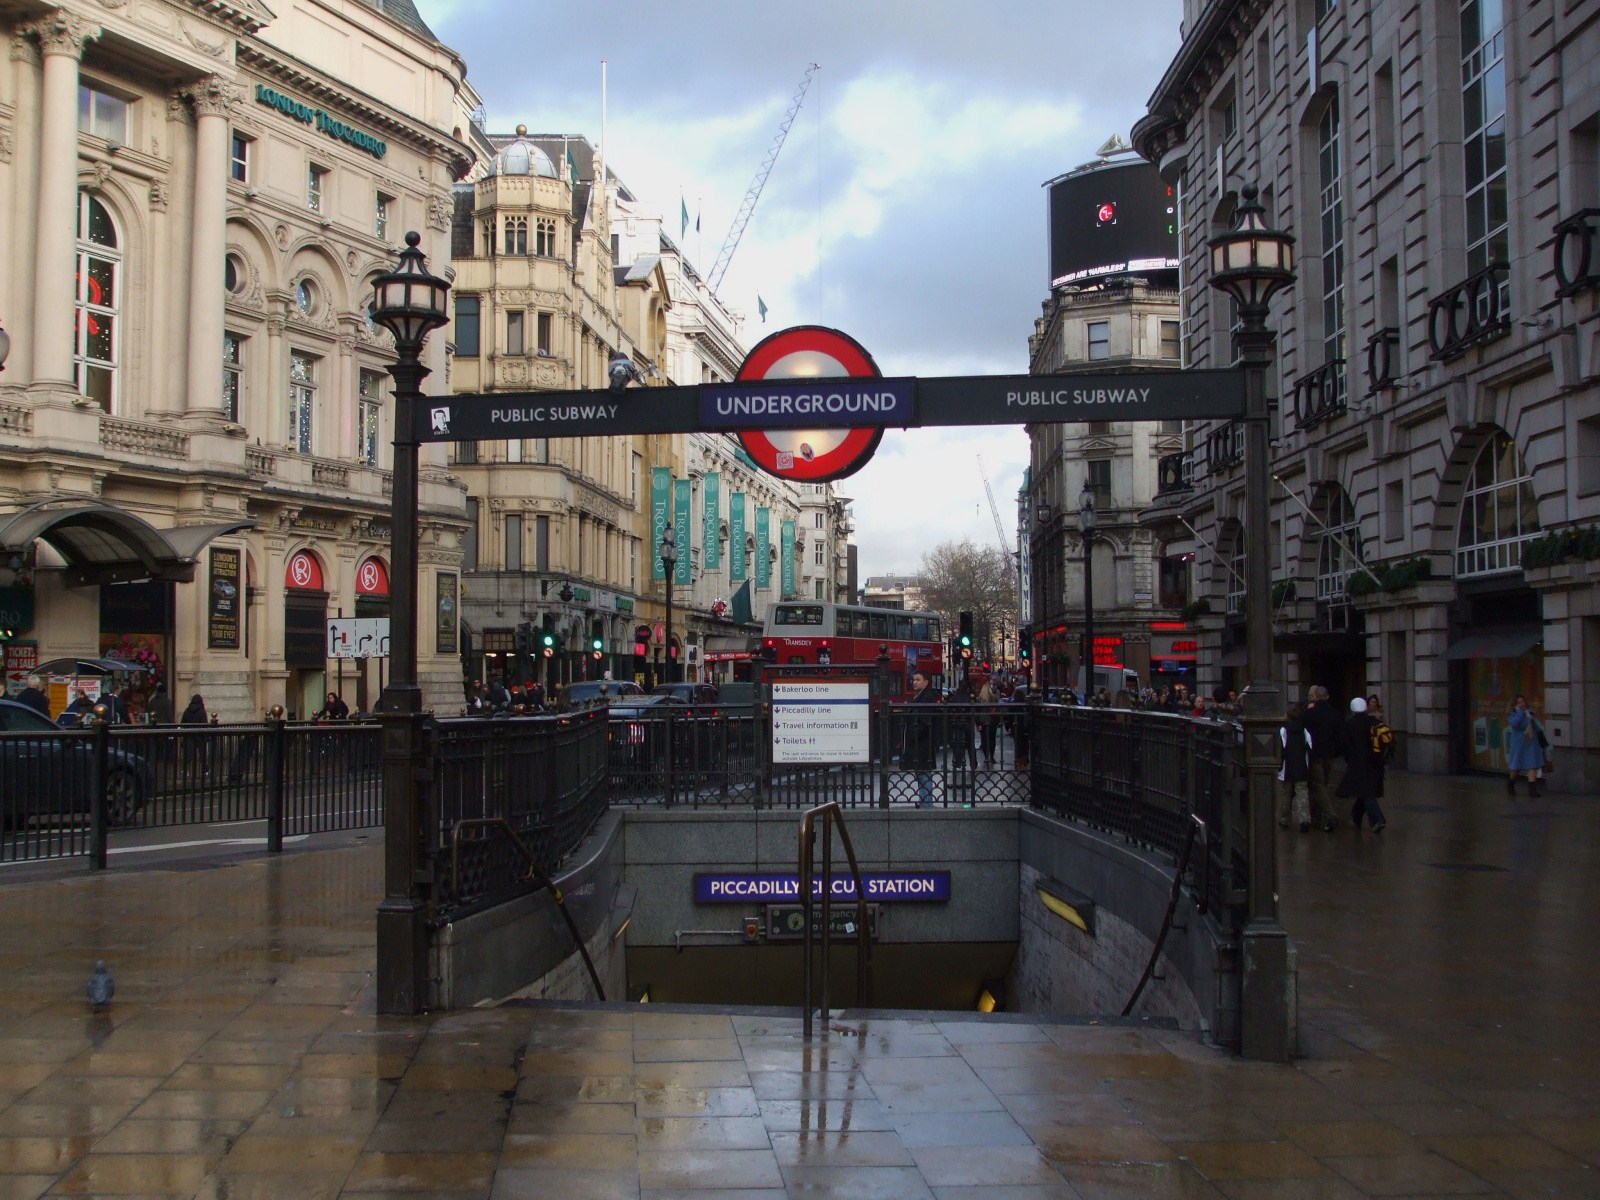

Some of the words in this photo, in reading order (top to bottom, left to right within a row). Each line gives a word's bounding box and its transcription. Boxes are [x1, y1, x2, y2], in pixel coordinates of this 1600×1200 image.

[256, 83, 314, 124] LONDON
[315, 109, 387, 158] TROCADERO
[1076, 269, 1088, 280] ARE
[717, 393, 896, 415] UNDERGROUND
[1006, 391, 1068, 406] PUBLIC
[1073, 388, 1150, 405] SUBWAY
[491, 408, 545, 423] PUBLIC
[549, 405, 618, 421] SUBWAY
[706, 500, 717, 563] TROCADERO
[677, 509, 688, 579] TROCADERO
[733, 517, 743, 575] TROCADERO
[213, 552, 237, 563] LONDON'S
[757, 530, 767, 583] TROCADERO
[783, 542, 792, 591] TROCADERO
[784, 637, 813, 646] TRANSDEV
[8, 647, 35, 658] TICKETS
[7, 658, 18, 669] ON
[19, 658, 35, 669] SALE
[781, 707, 815, 715] Piccadilly
[782, 737, 807, 745] Toilets
[711, 880, 800, 895] PICCADILLY
[868, 878, 935, 893] STATION
